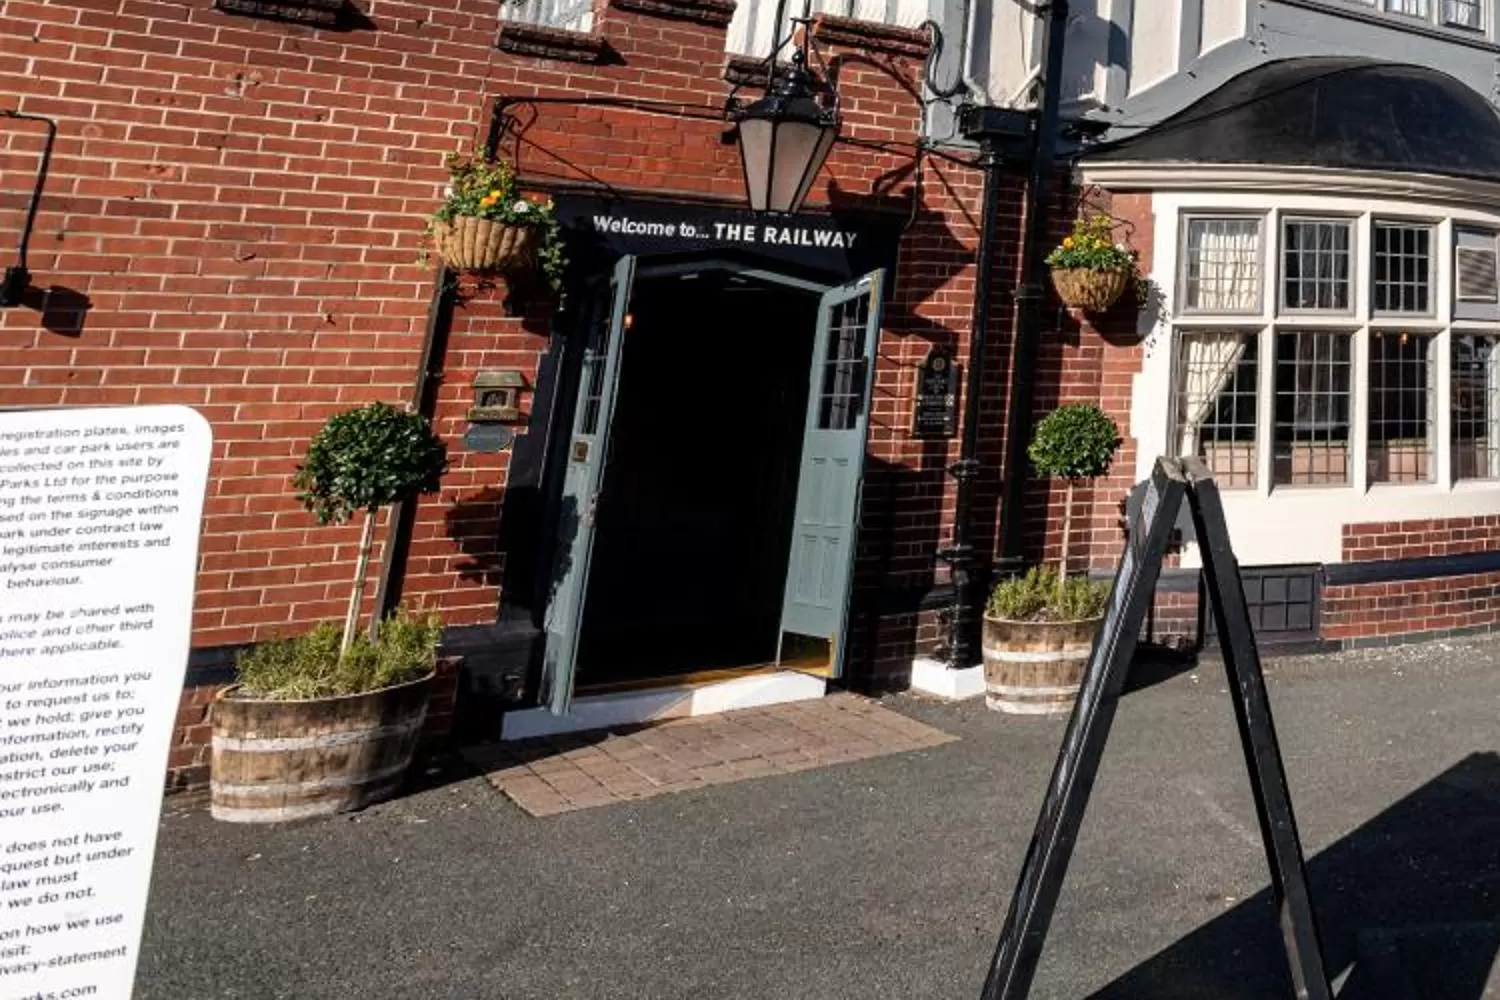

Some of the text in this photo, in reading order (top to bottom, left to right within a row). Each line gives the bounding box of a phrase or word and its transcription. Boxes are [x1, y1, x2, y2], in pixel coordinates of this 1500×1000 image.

[593, 216, 675, 237] Welcome
[714, 223, 756, 242] THE
[763, 226, 857, 249] RAILWAY
[135, 423, 185, 435] images
[24, 445, 50, 456] and
[54, 445, 77, 454] car
[80, 442, 110, 454] park
[116, 441, 155, 451] users
[158, 440, 180, 449] are
[67, 460, 85, 470] on
[89, 458, 114, 469] this
[117, 457, 143, 467] site
[147, 456, 164, 468] by
[44, 476, 67, 487] Ltd
[71, 475, 91, 486] for
[95, 474, 117, 485] the
[121, 472, 179, 485] purpose
[21, 495, 43, 505] the
[48, 493, 87, 504] terms
[92, 490, 101, 501] &
[105, 488, 179, 501] conditions
[29, 512, 46, 521] on
[51, 510, 73, 520] the
[78, 507, 133, 520] signage
[137, 504, 179, 515] within
[30, 526, 72, 538] under
[75, 521, 135, 535] contract
[140, 521, 163, 531] law
[78, 538, 140, 551] interests
[144, 536, 171, 547] and
[41, 557, 113, 571] consumer
[8, 612, 40, 623] may
[46, 609, 64, 620] be
[70, 604, 121, 618] shared
[125, 603, 155, 614] with
[41, 625, 72, 637] and
[76, 623, 115, 634] other
[120, 619, 154, 631] third
[28, 673, 119, 690] information
[124, 671, 152, 684] you
[5, 700, 21, 710] to
[27, 692, 87, 708] request
[92, 692, 110, 702] us
[7, 717, 31, 727] we
[80, 710, 112, 722] give
[118, 707, 145, 720] you
[95, 722, 144, 736] rectify
[49, 744, 99, 759] delete
[103, 741, 138, 757] your
[52, 765, 78, 776] our
[99, 776, 129, 789] and
[6, 831, 123, 853] does not have
[54, 852, 81, 865] but
[86, 846, 134, 861] under
[36, 870, 79, 886] must
[8, 897, 33, 909] we
[38, 892, 59, 904] do
[26, 923, 61, 936] how
[66, 919, 91, 930] we
[95, 913, 123, 926] use
